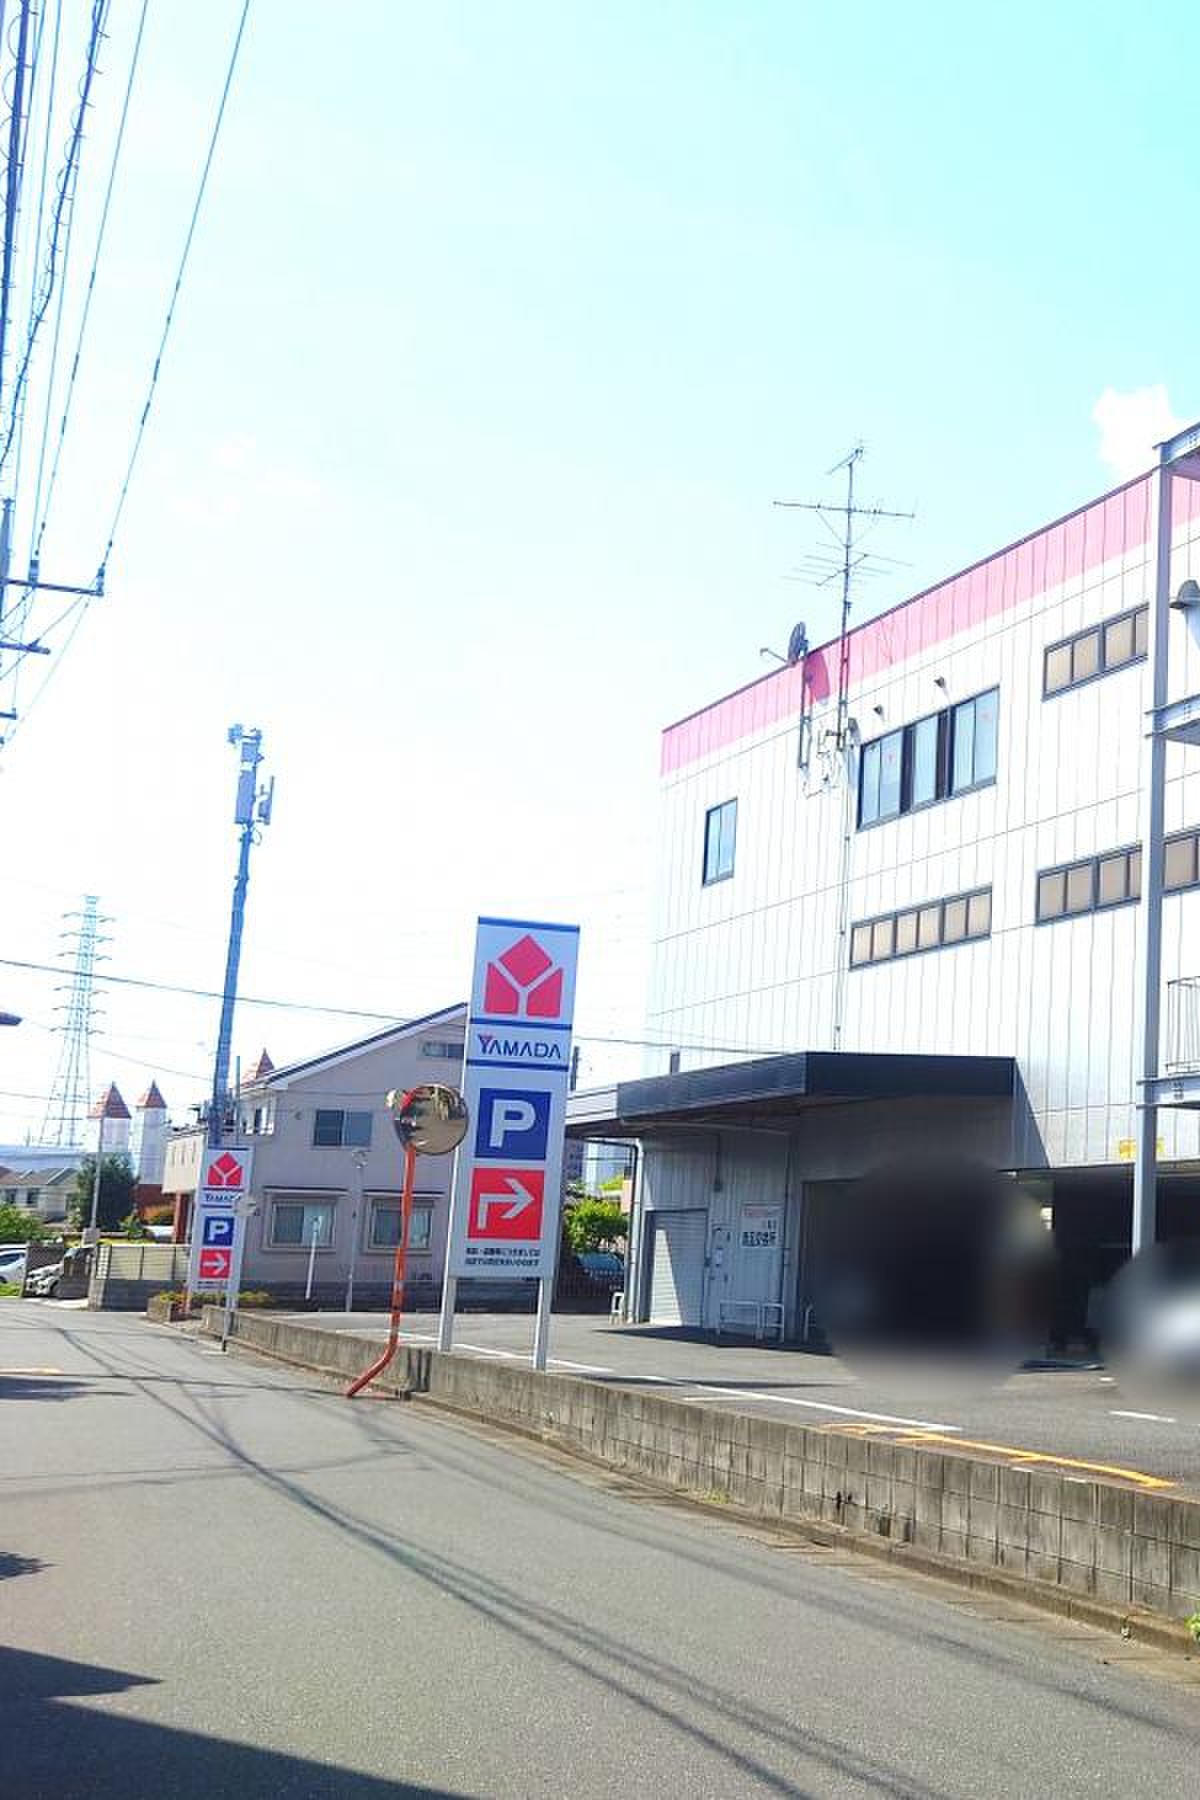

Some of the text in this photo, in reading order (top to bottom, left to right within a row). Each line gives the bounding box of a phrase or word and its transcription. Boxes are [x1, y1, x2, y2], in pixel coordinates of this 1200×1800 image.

[477, 1033, 561, 1059] YAMADA
[489, 1099, 536, 1147] P
[208, 1220, 229, 1241] P
